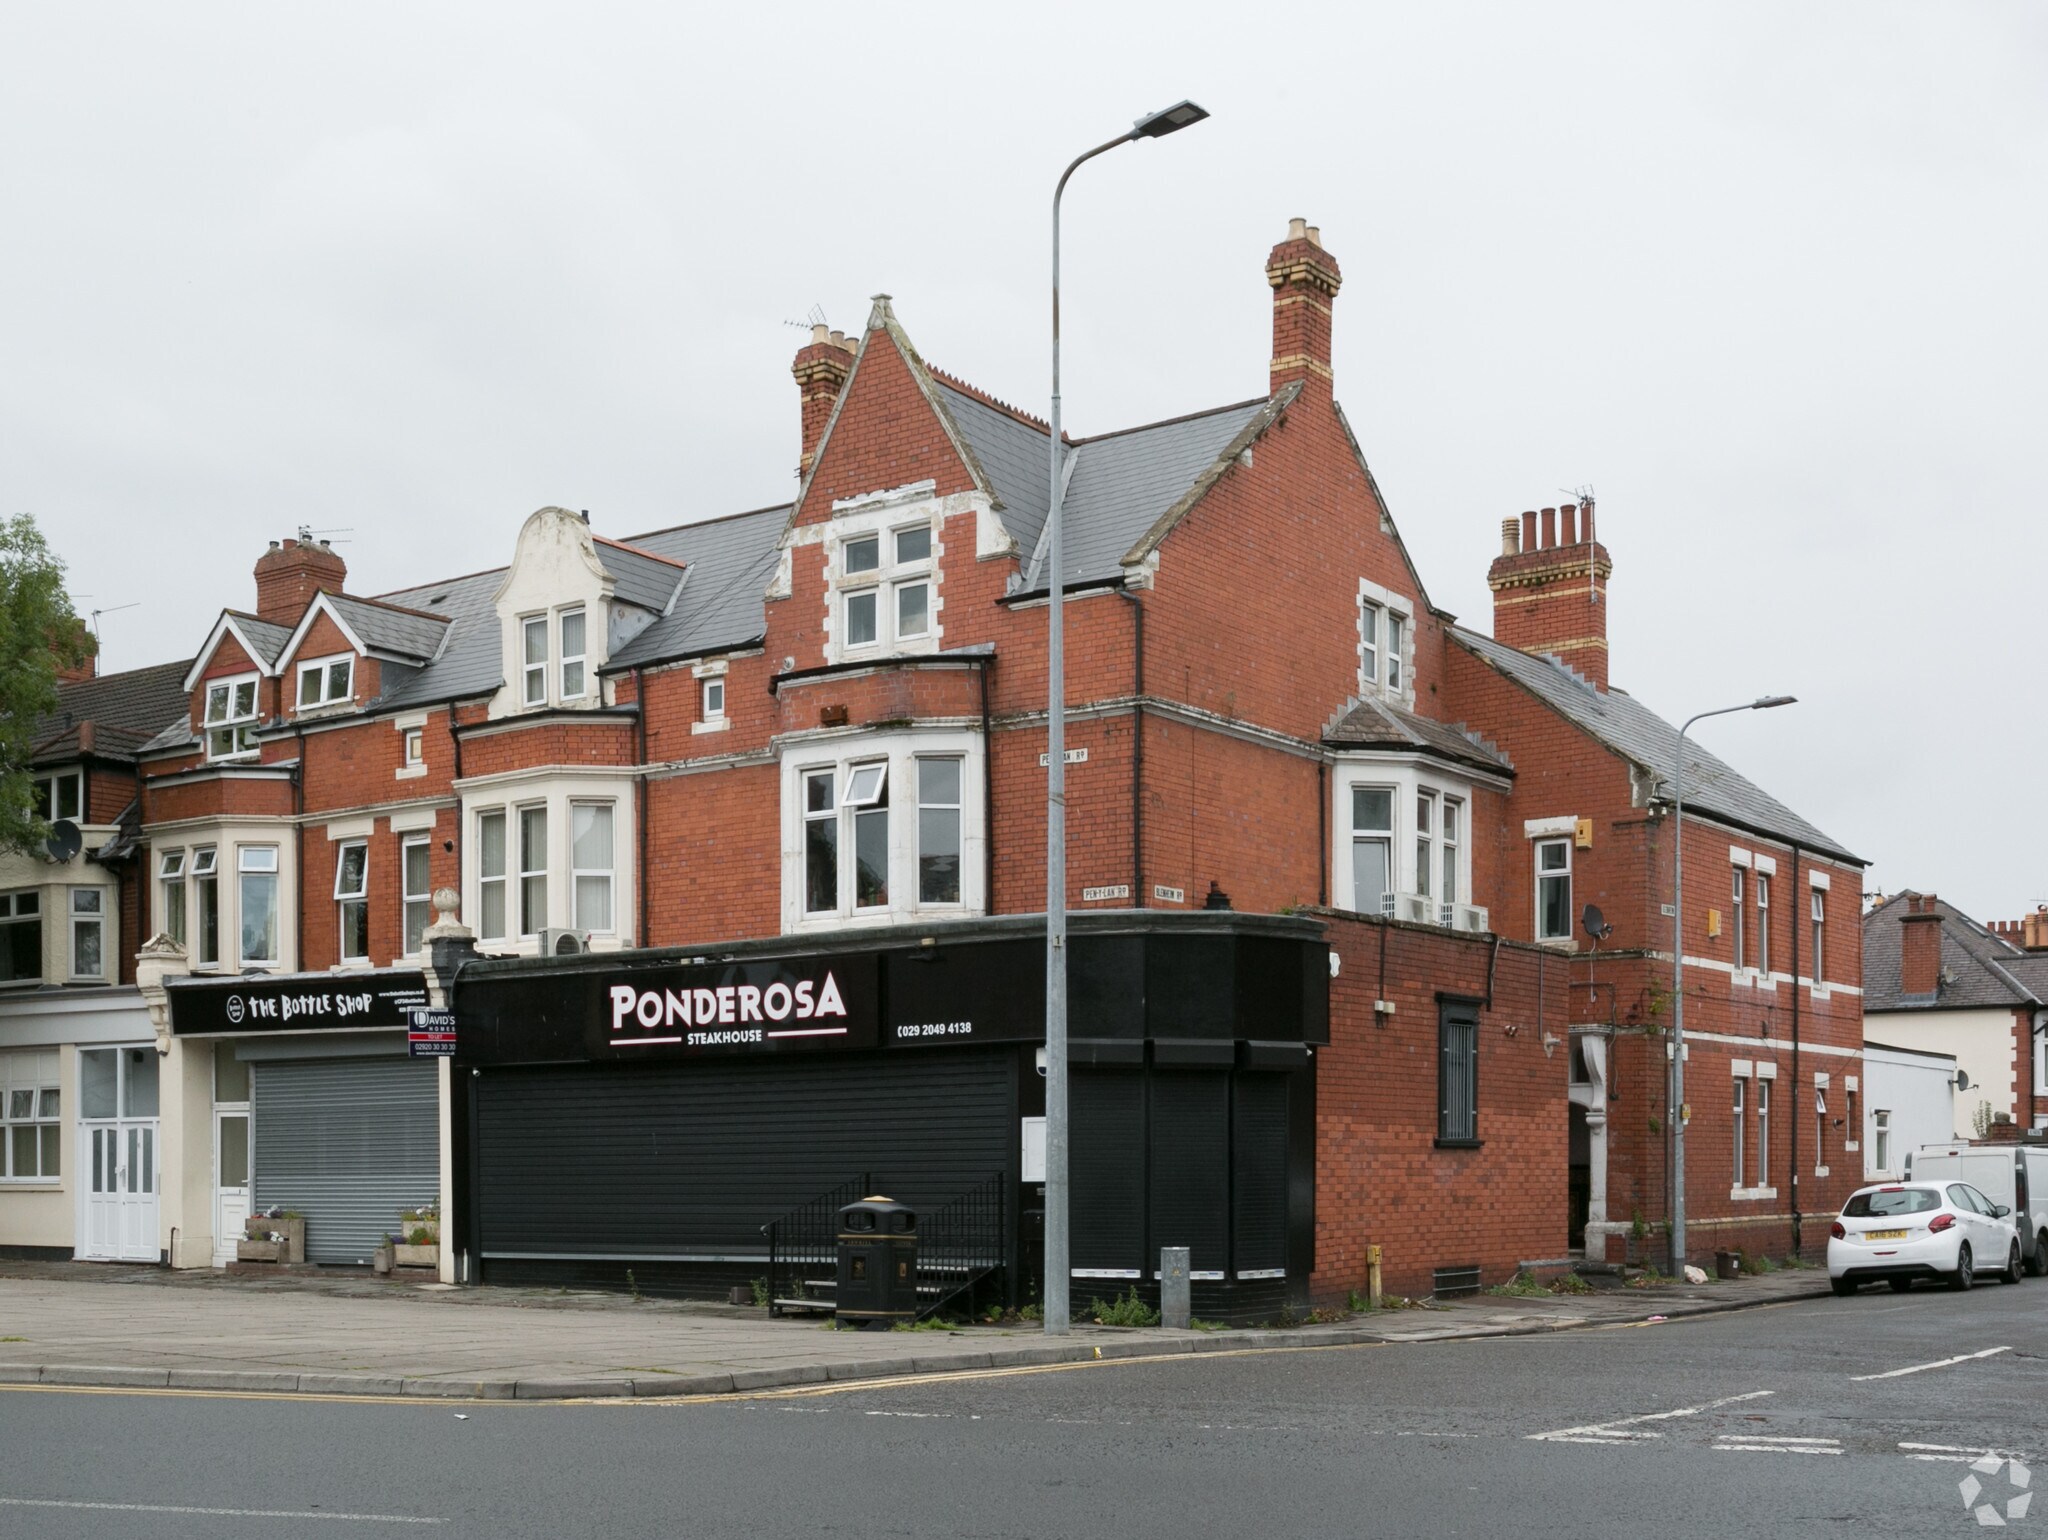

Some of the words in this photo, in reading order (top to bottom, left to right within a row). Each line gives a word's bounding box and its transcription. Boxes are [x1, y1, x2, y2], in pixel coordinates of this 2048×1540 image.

[1085, 888, 1115, 899] PEN-Y-LAN
[1156, 887, 1175, 899] BLENHEIM
[1055, 935, 1060, 945] 1
[248, 996, 278, 1018] THE
[281, 994, 332, 1021] BOTTLE
[335, 993, 373, 1017] SHOP
[609, 969, 848, 1029] PONDEROSA
[414, 1010, 456, 1028] DAVID'S
[902, 1025, 920, 1037] 029
[922, 1023, 946, 1036] 2049
[947, 1021, 972, 1034] 4138
[687, 1029, 763, 1046] STEAKHOUSE
